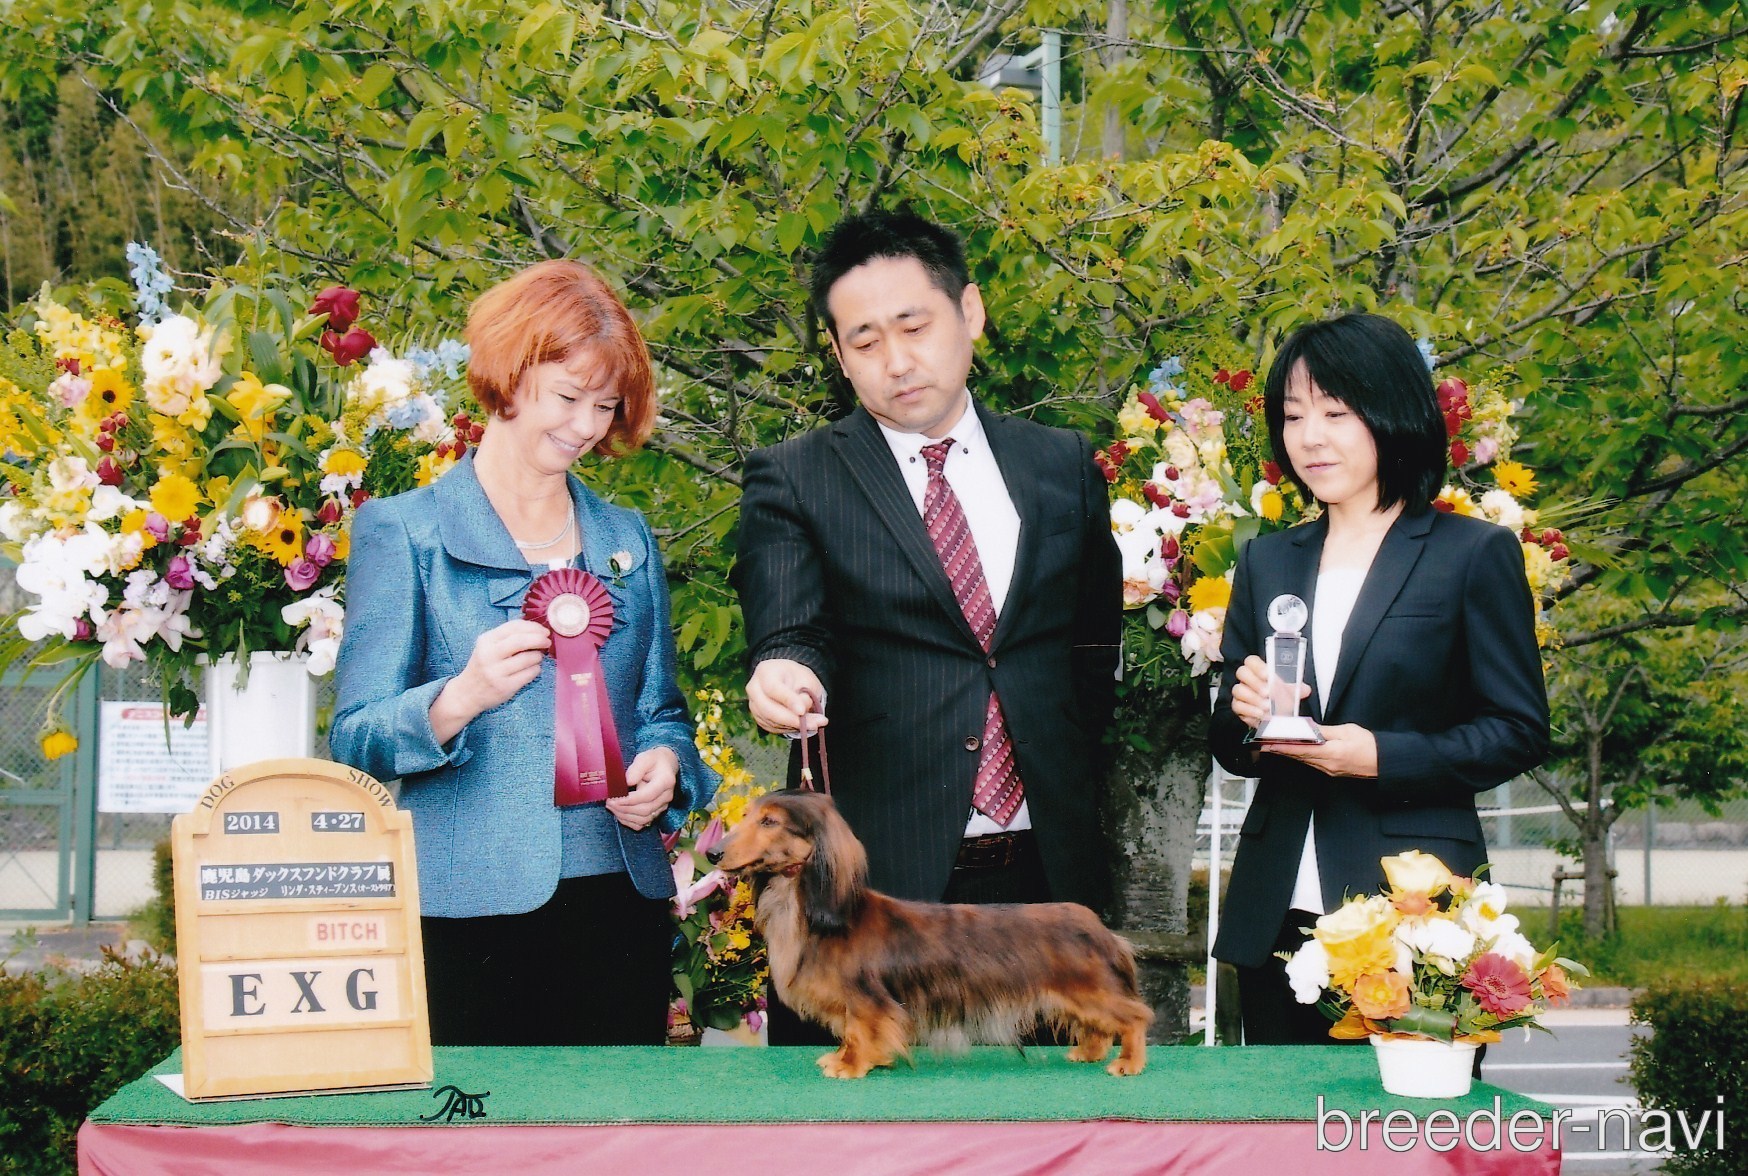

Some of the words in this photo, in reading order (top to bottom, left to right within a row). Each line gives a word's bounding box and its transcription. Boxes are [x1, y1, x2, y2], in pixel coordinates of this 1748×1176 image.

[201, 775, 235, 810] DOG
[347, 769, 394, 808] SHOW
[227, 814, 276, 830] 2014
[205, 887, 269, 900] BISジャッジ
[317, 923, 378, 940] BITCH
